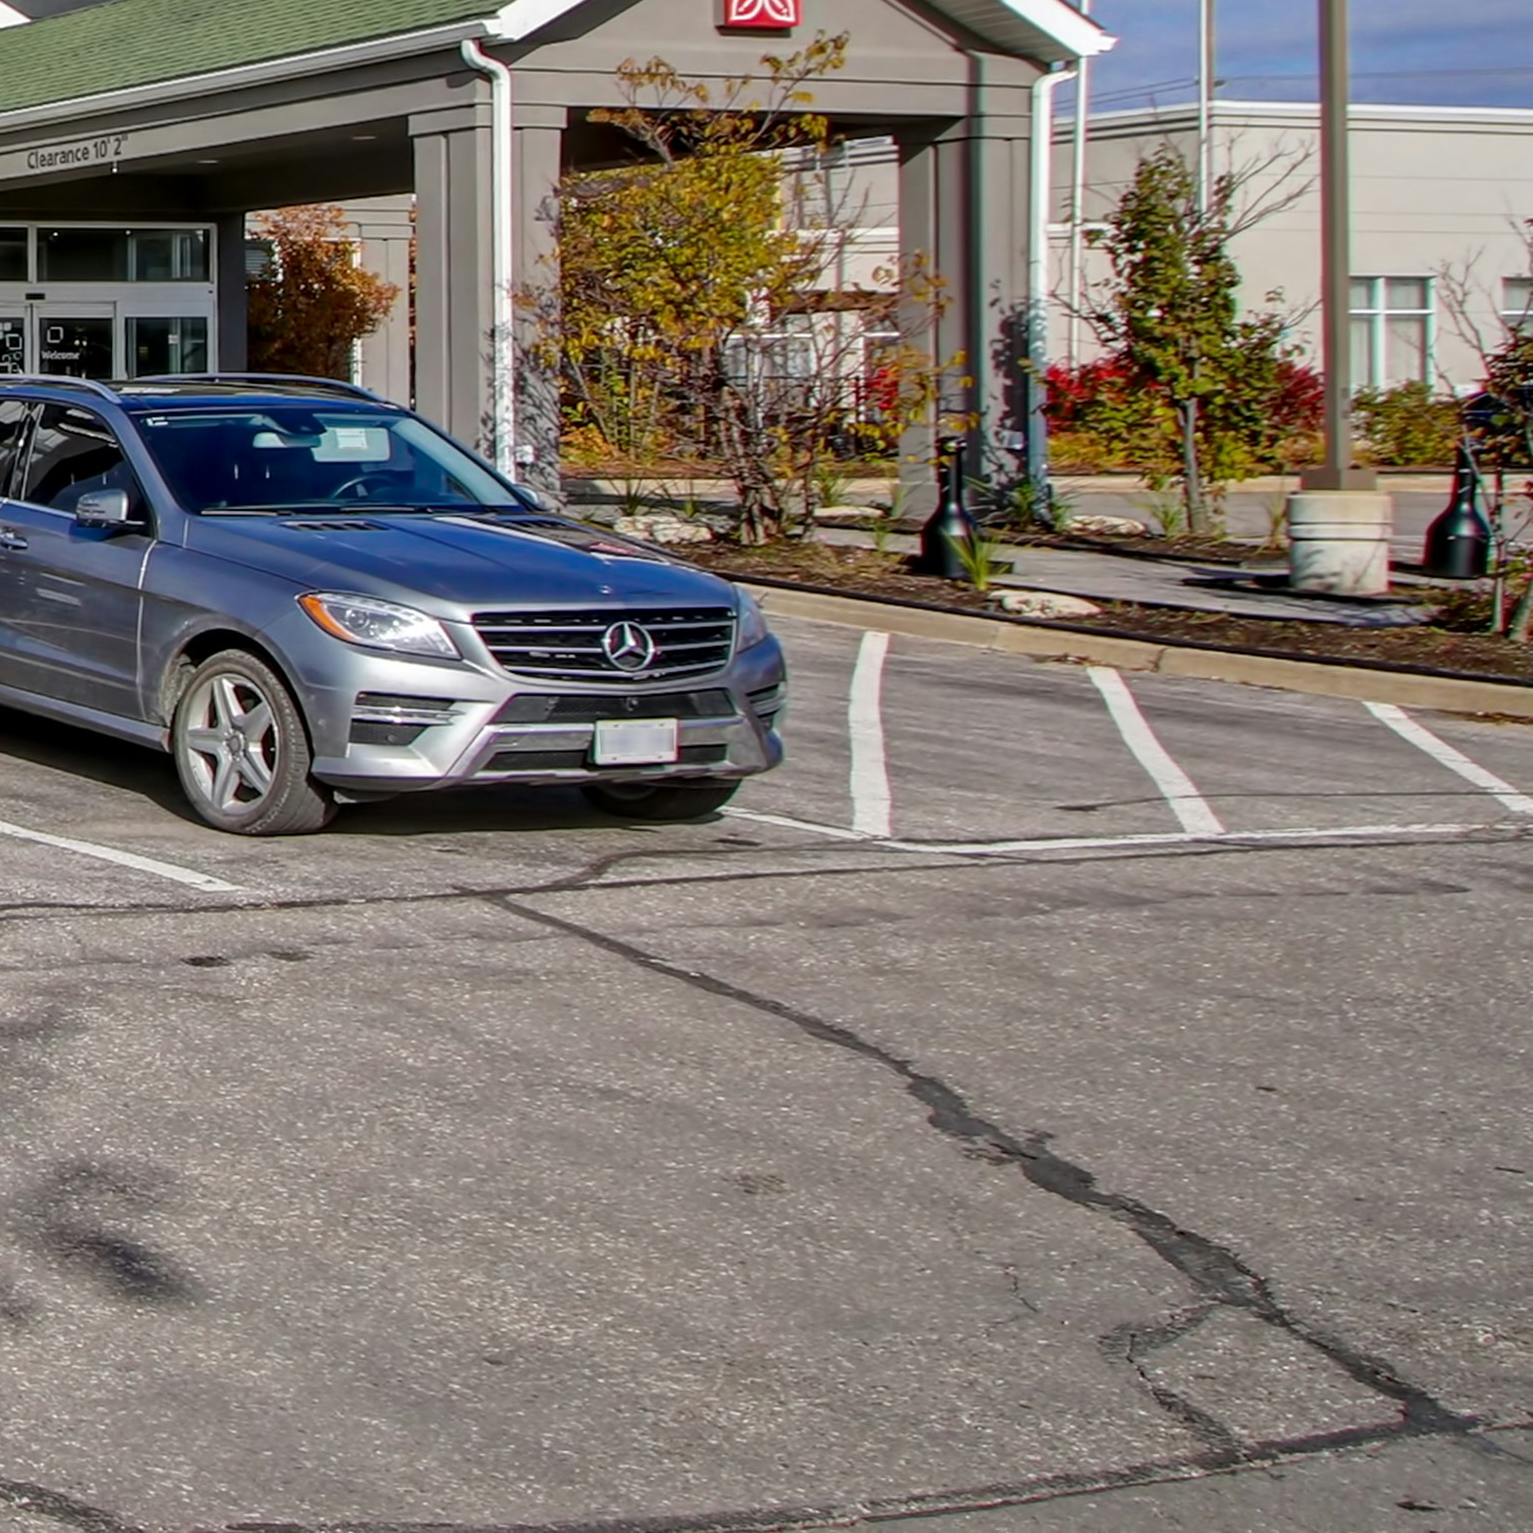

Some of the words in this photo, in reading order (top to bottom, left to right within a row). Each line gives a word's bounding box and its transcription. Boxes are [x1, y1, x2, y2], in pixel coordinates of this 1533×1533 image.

[27, 146, 90, 169] Clearance
[93, 137, 111, 159] 10'
[42, 350, 80, 360] Welcome
